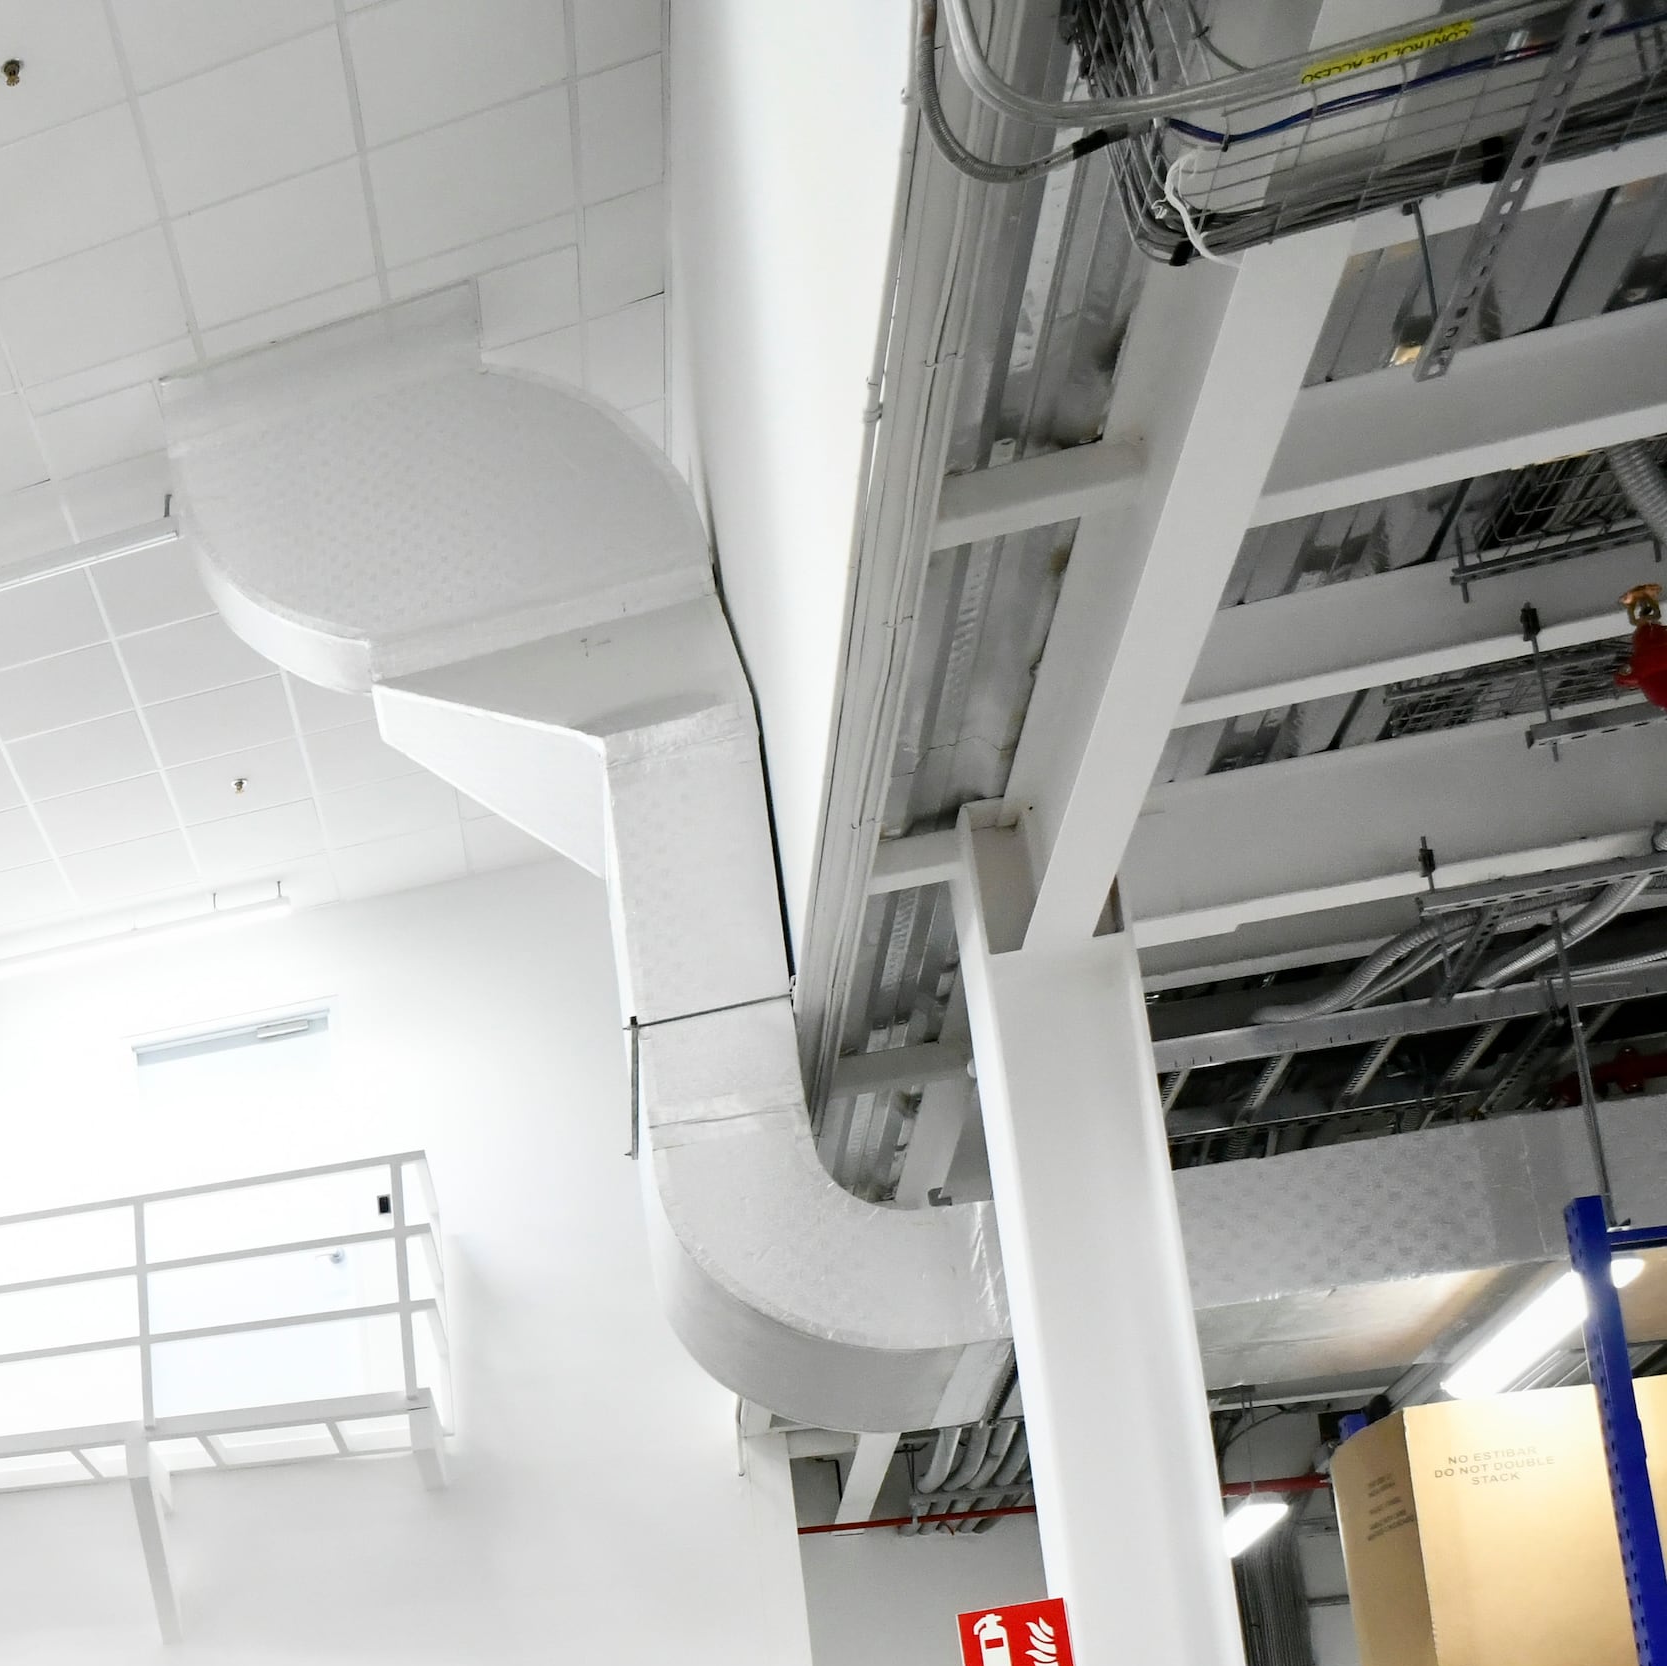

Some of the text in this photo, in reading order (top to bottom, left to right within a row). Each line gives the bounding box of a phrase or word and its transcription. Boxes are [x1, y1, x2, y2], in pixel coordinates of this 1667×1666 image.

[1448, 1446, 1538, 1465] NO ESTIBAR
[1434, 1456, 1556, 1479] DO NOT DOUBLE
[1471, 1472, 1521, 1486] STACK
